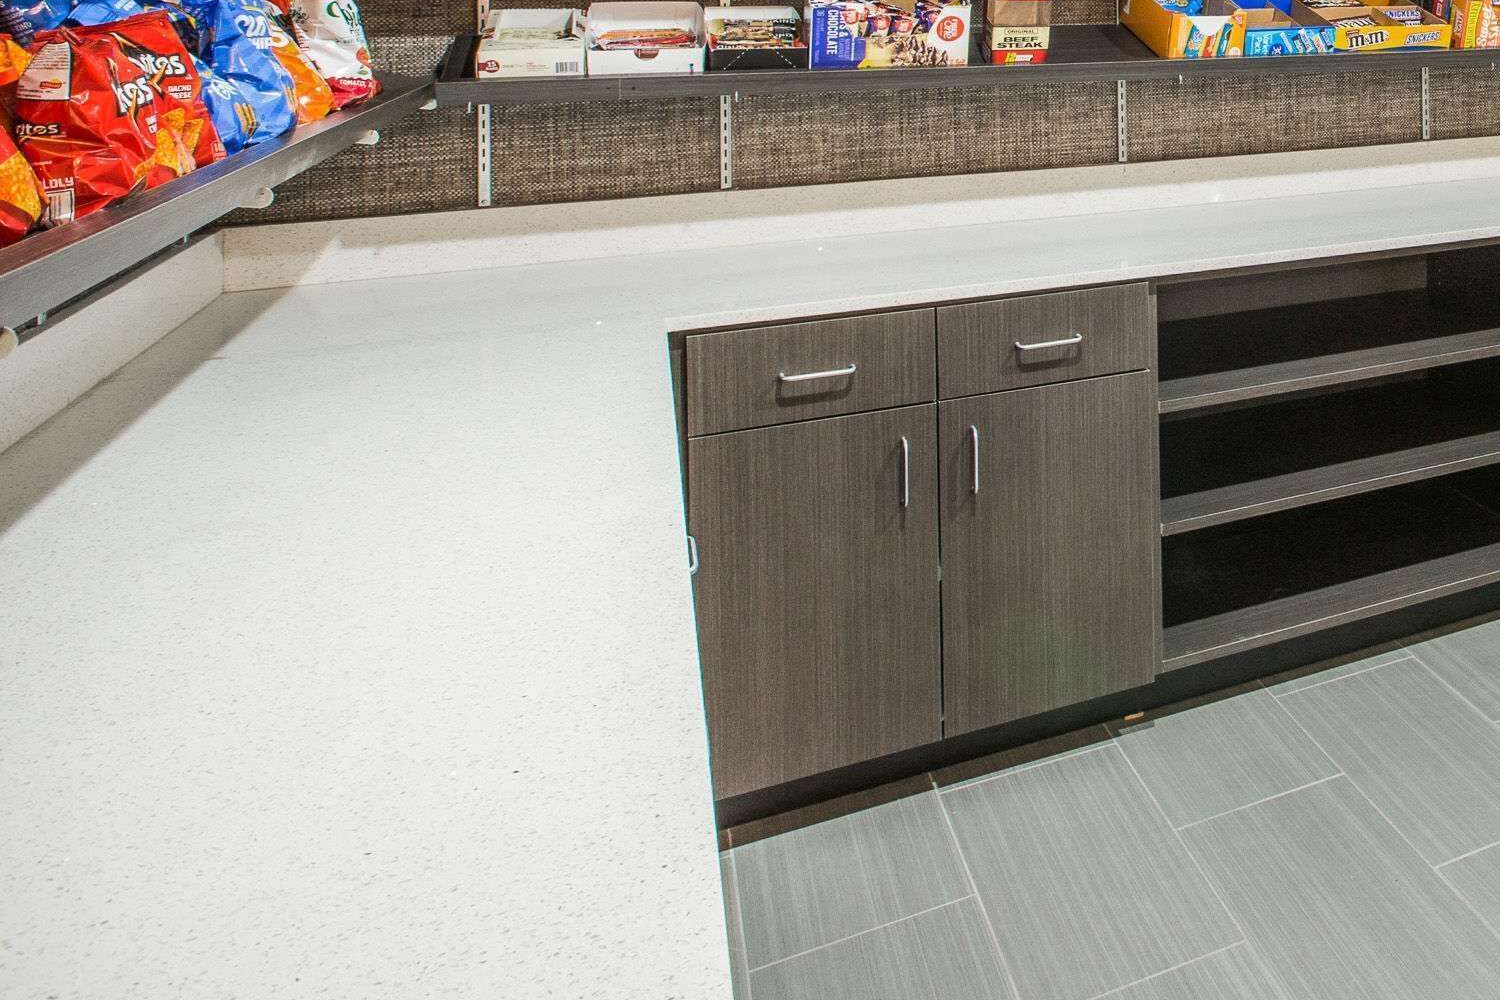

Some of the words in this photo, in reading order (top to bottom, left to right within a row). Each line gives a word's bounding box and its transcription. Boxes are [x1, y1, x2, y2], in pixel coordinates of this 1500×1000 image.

[1385, 9, 1419, 19] NICKERS
[826, 9, 839, 55] CHOCOLATE
[1407, 31, 1440, 44] SNICKERS
[16, 124, 60, 135] ritos
[44, 177, 75, 190] LDLY
